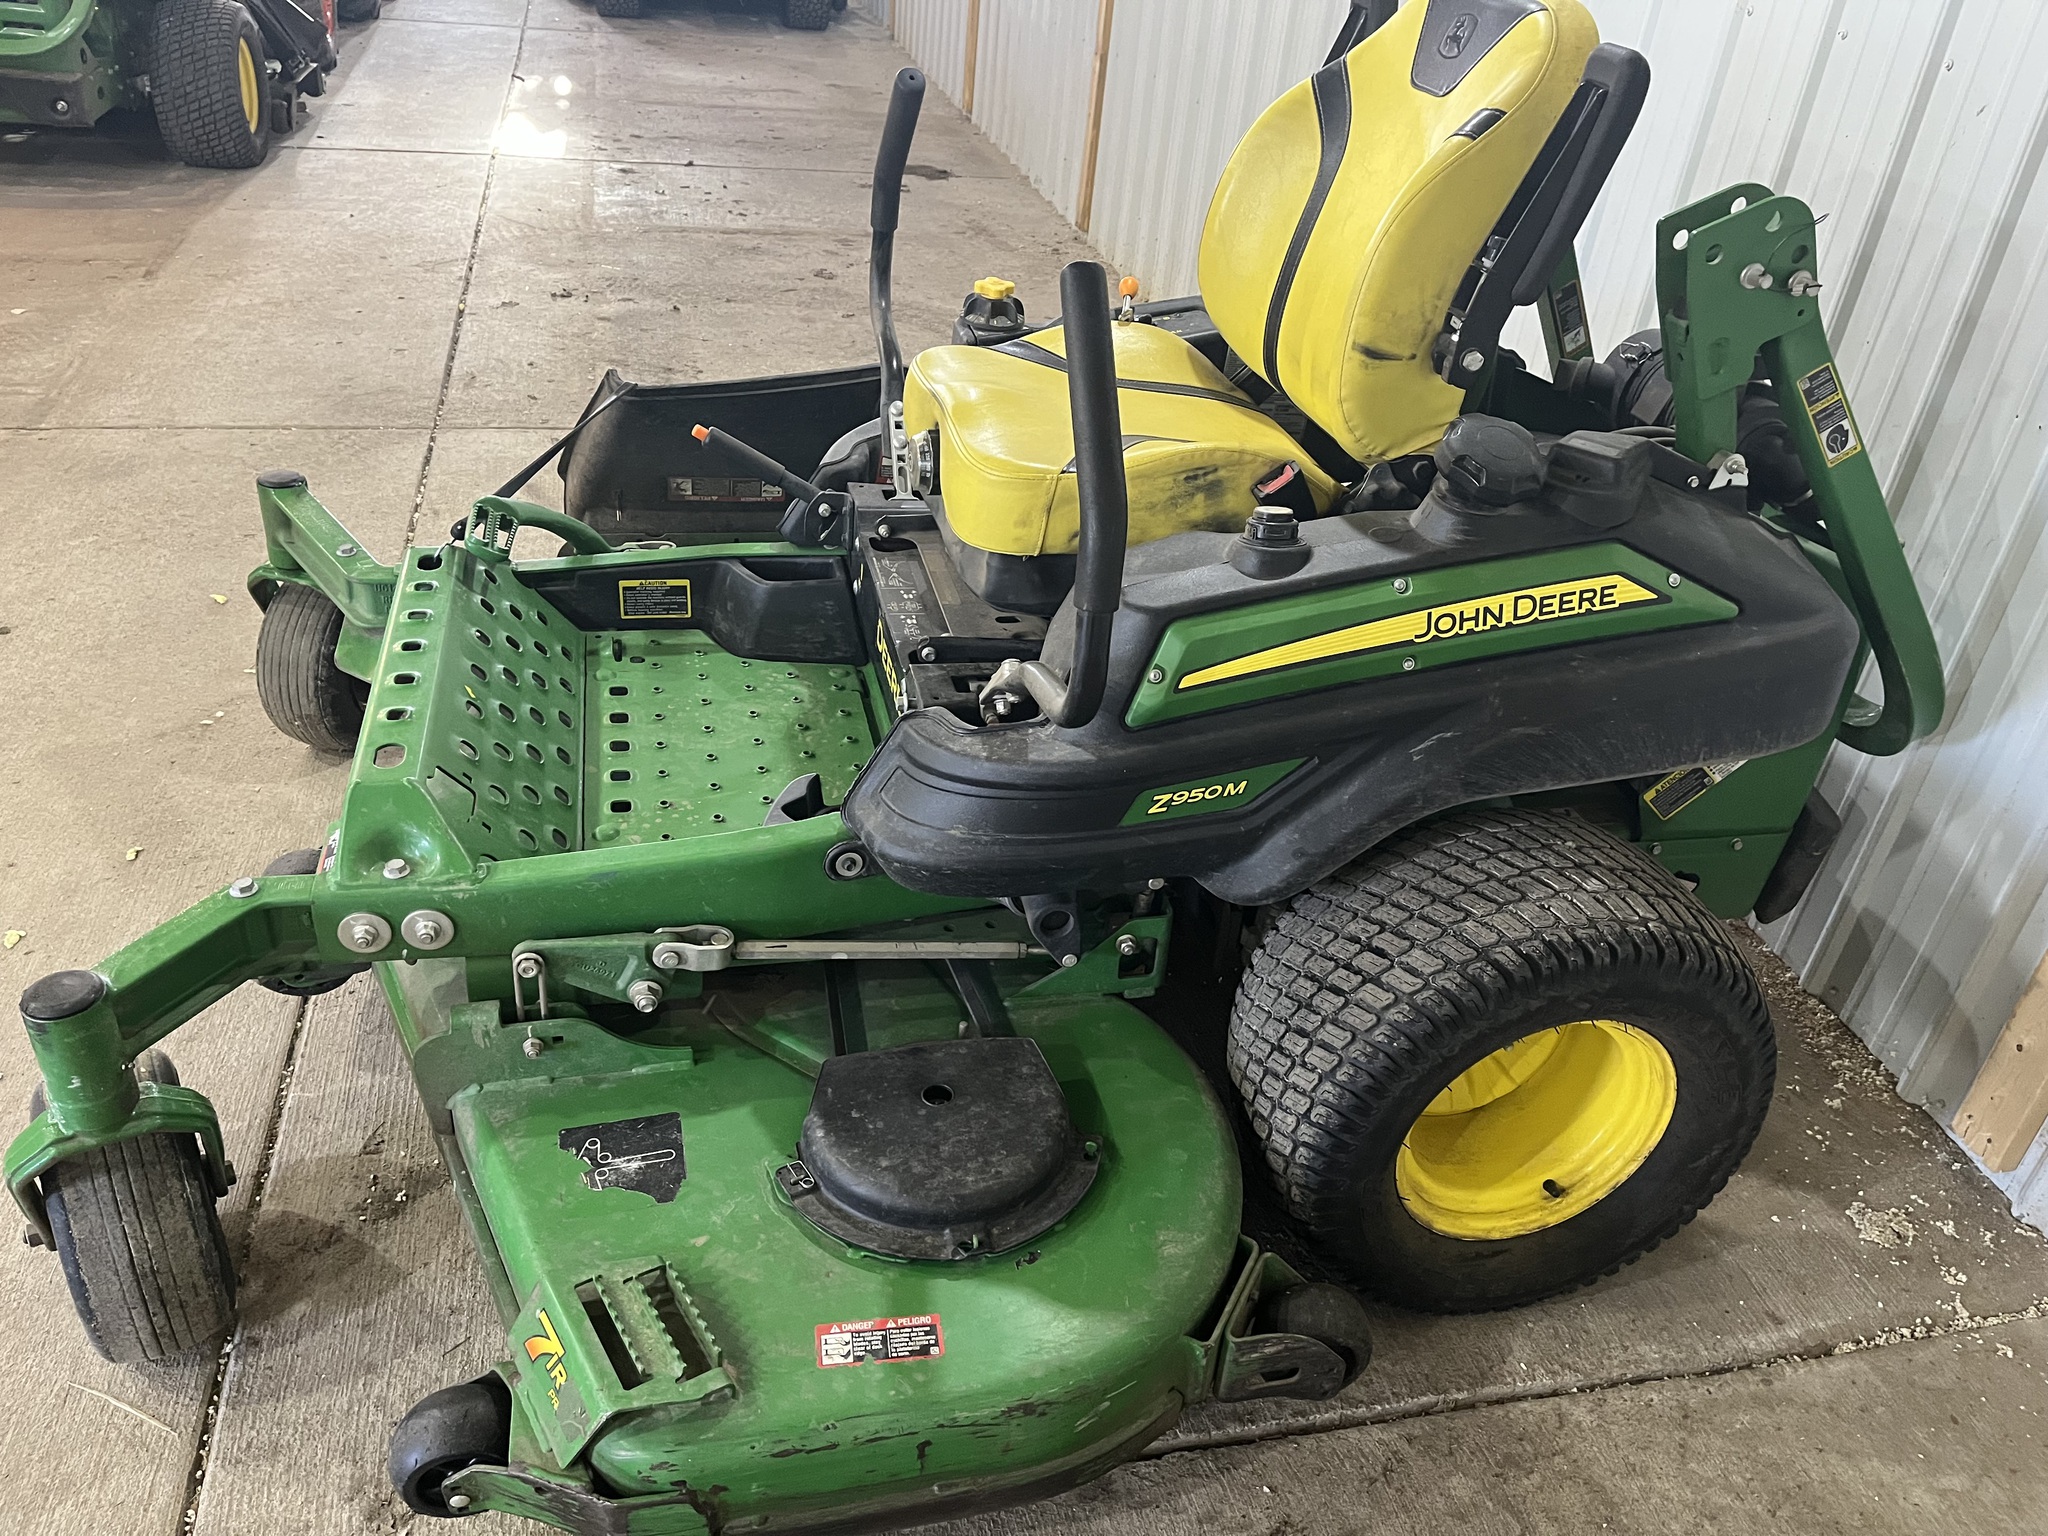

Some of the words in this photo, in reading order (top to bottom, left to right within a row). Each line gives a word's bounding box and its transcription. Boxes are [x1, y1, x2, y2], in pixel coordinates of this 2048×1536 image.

[1414, 603, 1504, 640] JOHN
[1513, 584, 1618, 622] DEERE
[898, 1316, 932, 1326] PELIGRO
